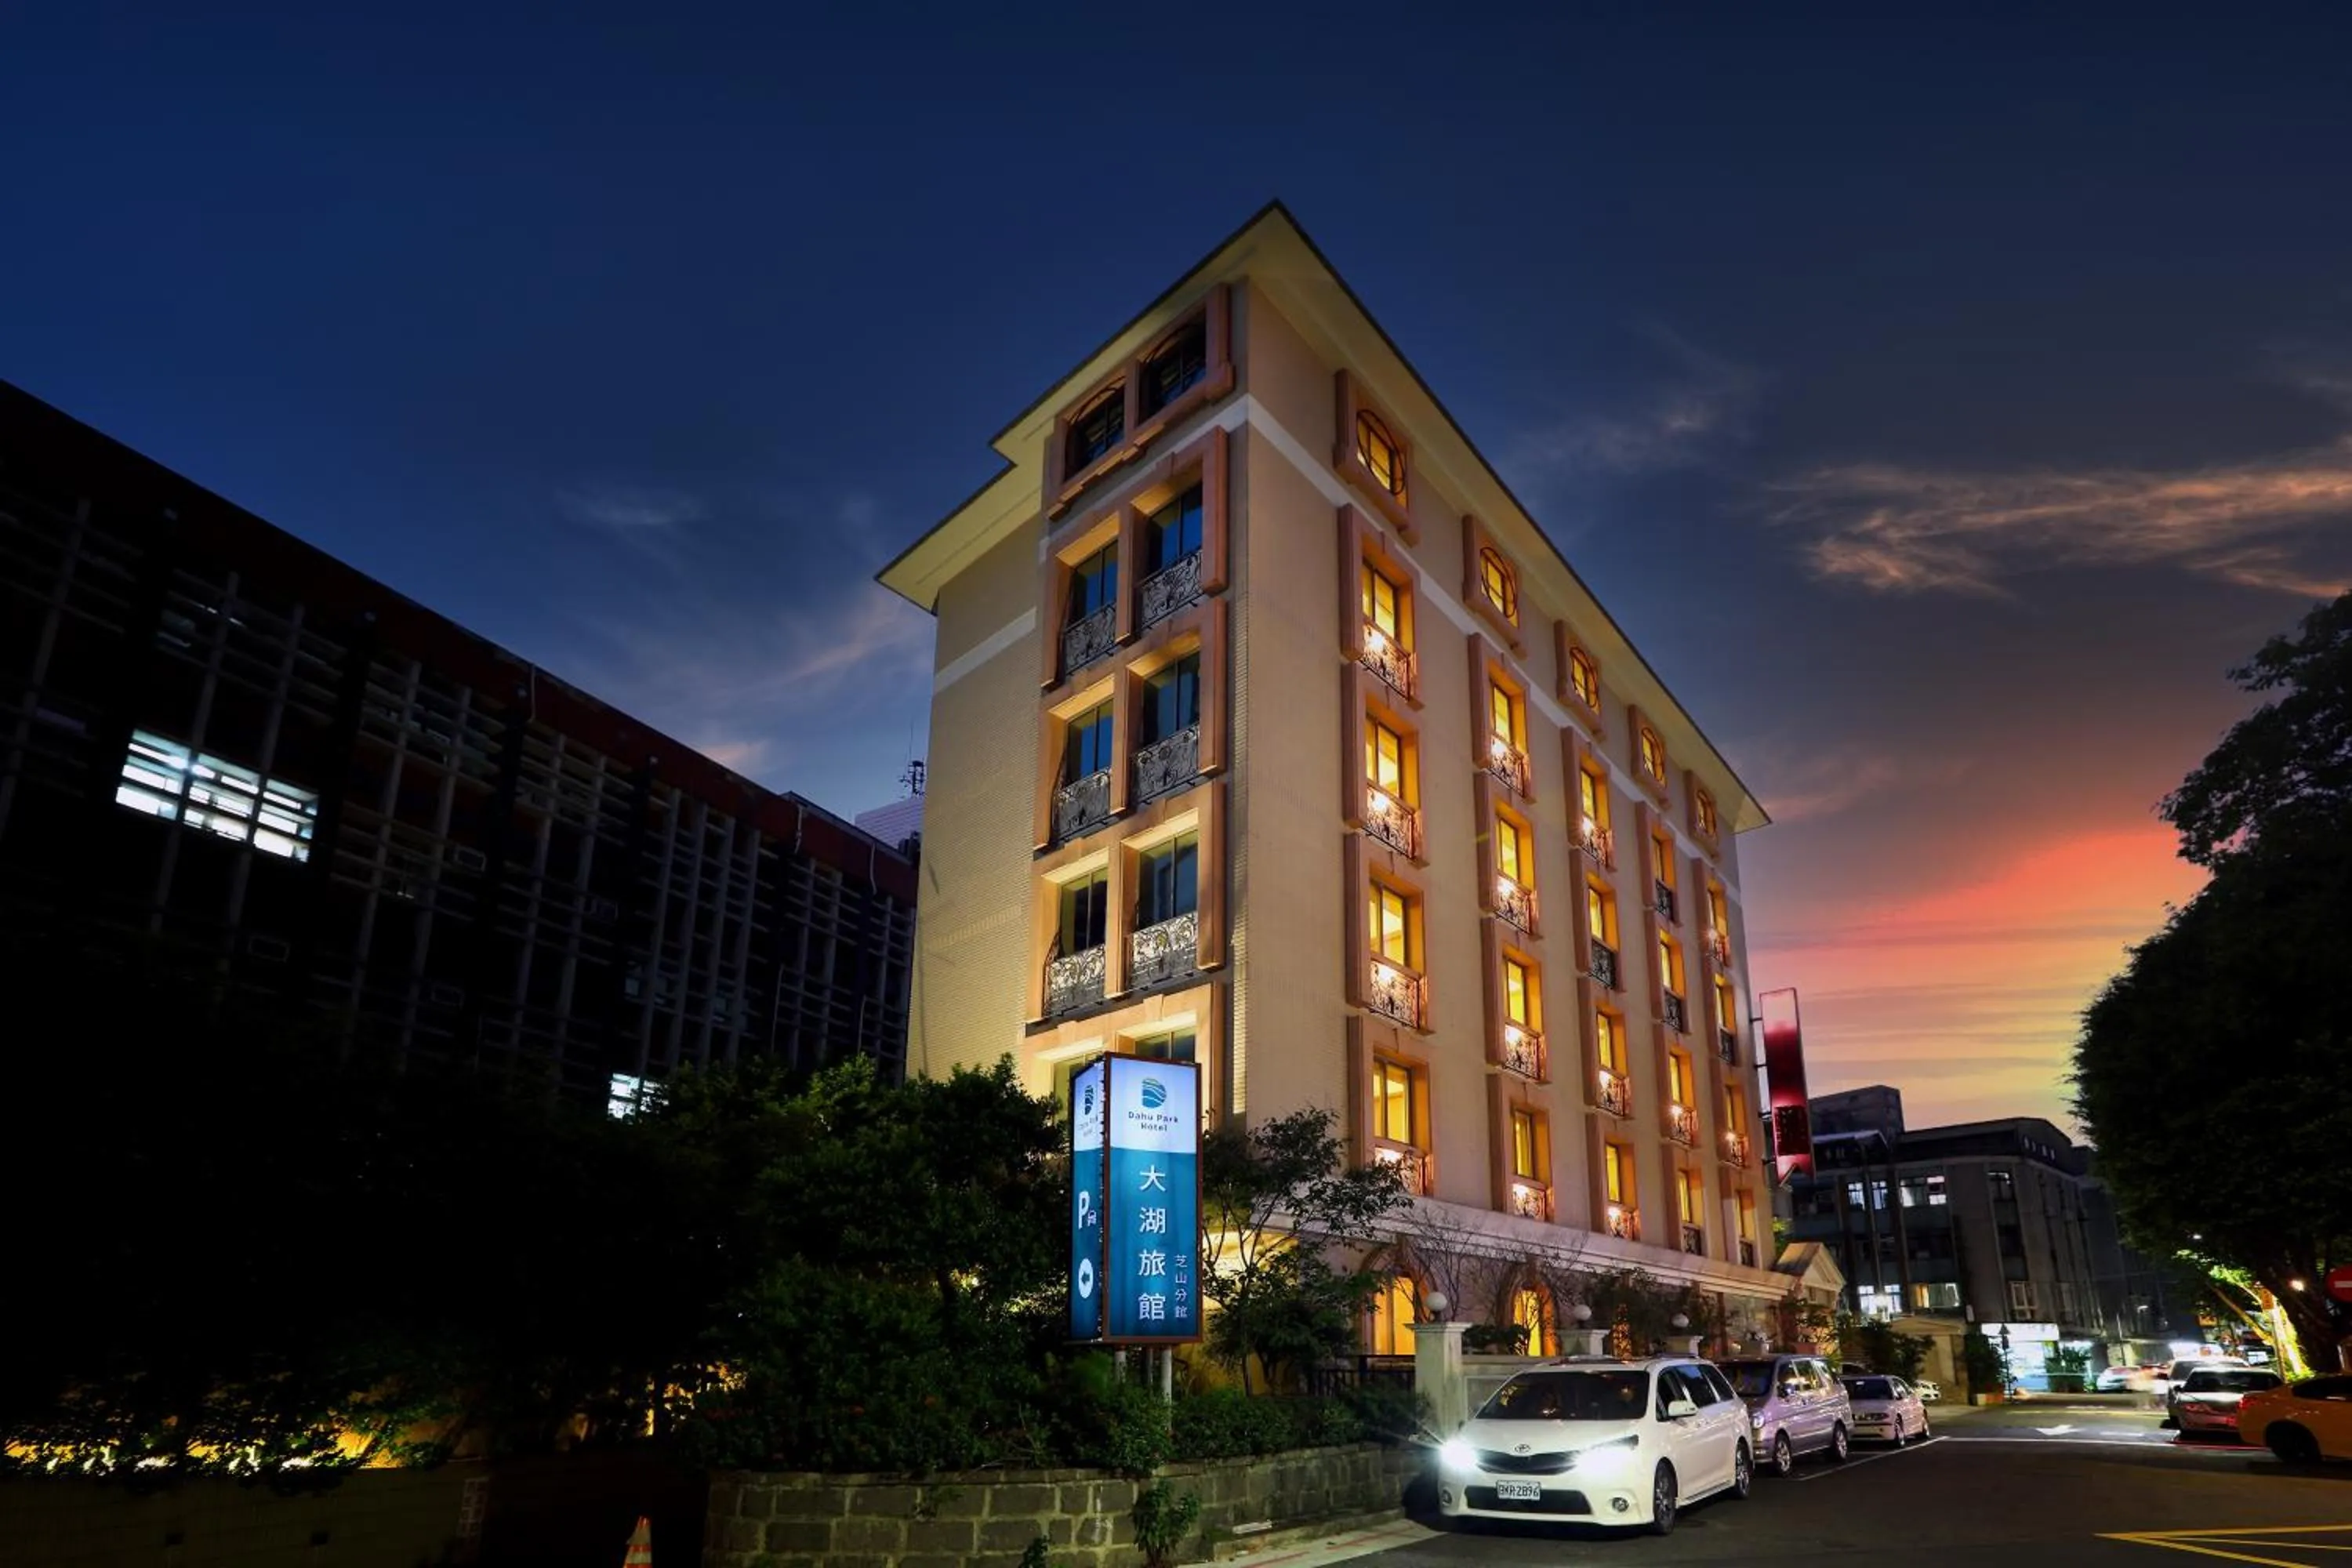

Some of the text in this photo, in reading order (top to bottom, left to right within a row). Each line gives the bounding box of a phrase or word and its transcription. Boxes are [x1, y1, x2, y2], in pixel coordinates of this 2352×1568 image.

[1128, 1111, 1178, 1123] Dahu Park
[1141, 1122, 1167, 1132] Hotel
[1138, 1164, 1167, 1321] 大湖旅館
[1174, 1254, 1188, 1319] 芝山分館
